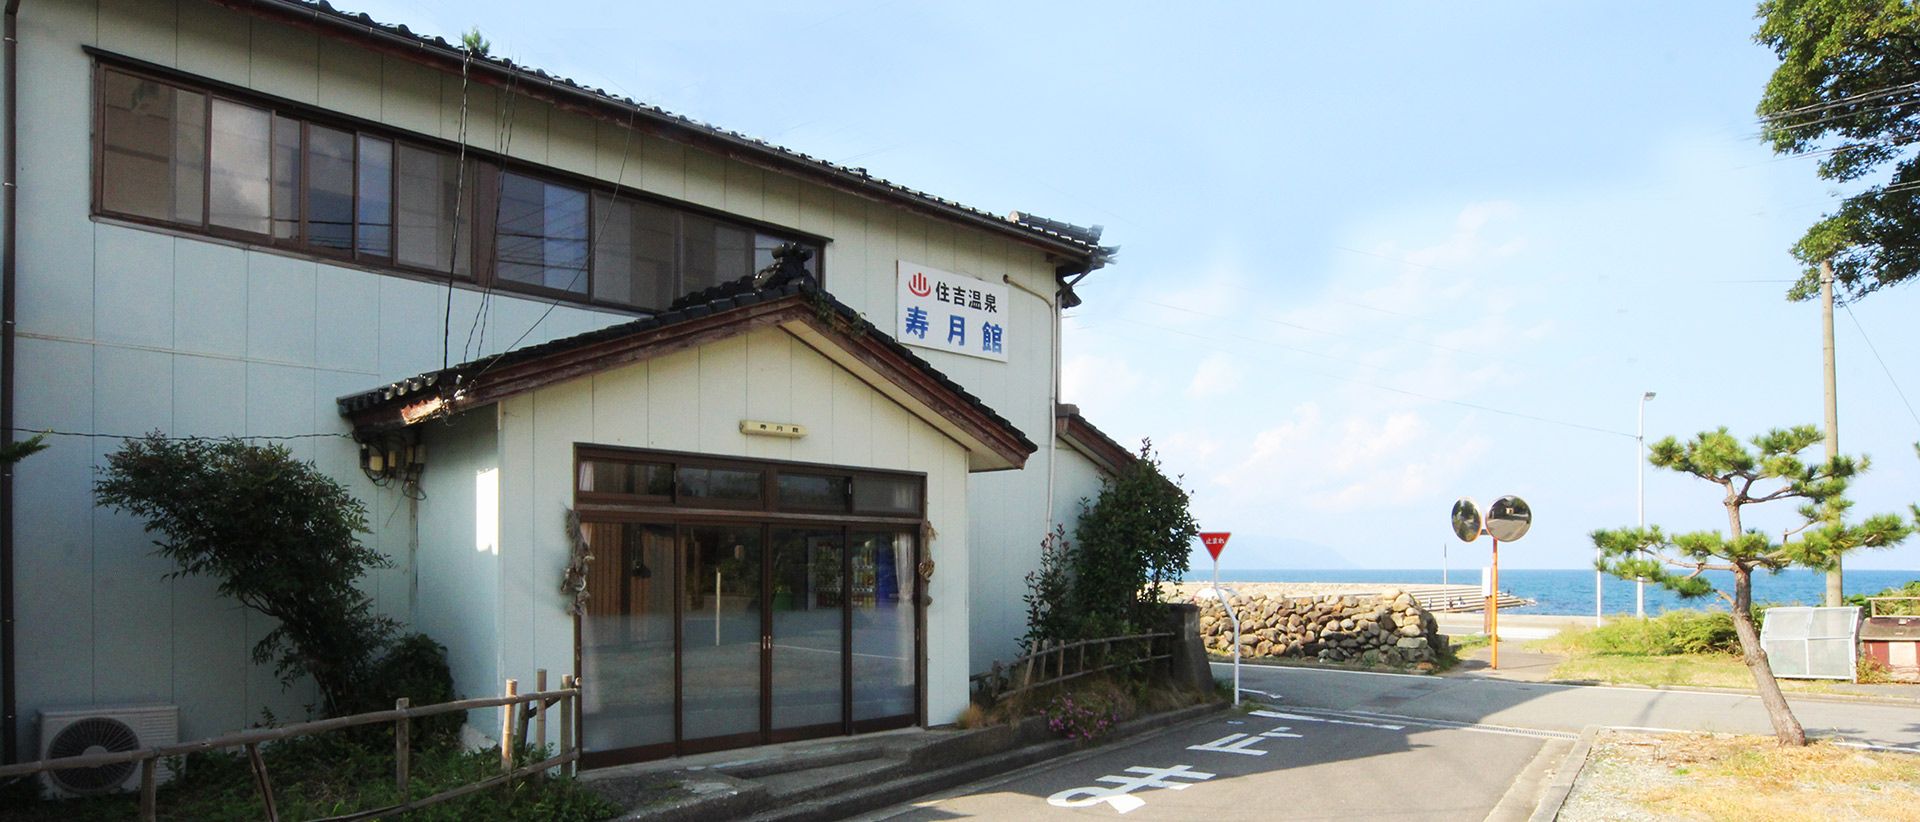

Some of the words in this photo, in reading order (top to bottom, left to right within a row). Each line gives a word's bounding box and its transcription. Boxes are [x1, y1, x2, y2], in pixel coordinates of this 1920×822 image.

[935, 281, 998, 314] 住吉温泉
[905, 306, 1003, 354] 寿月館
